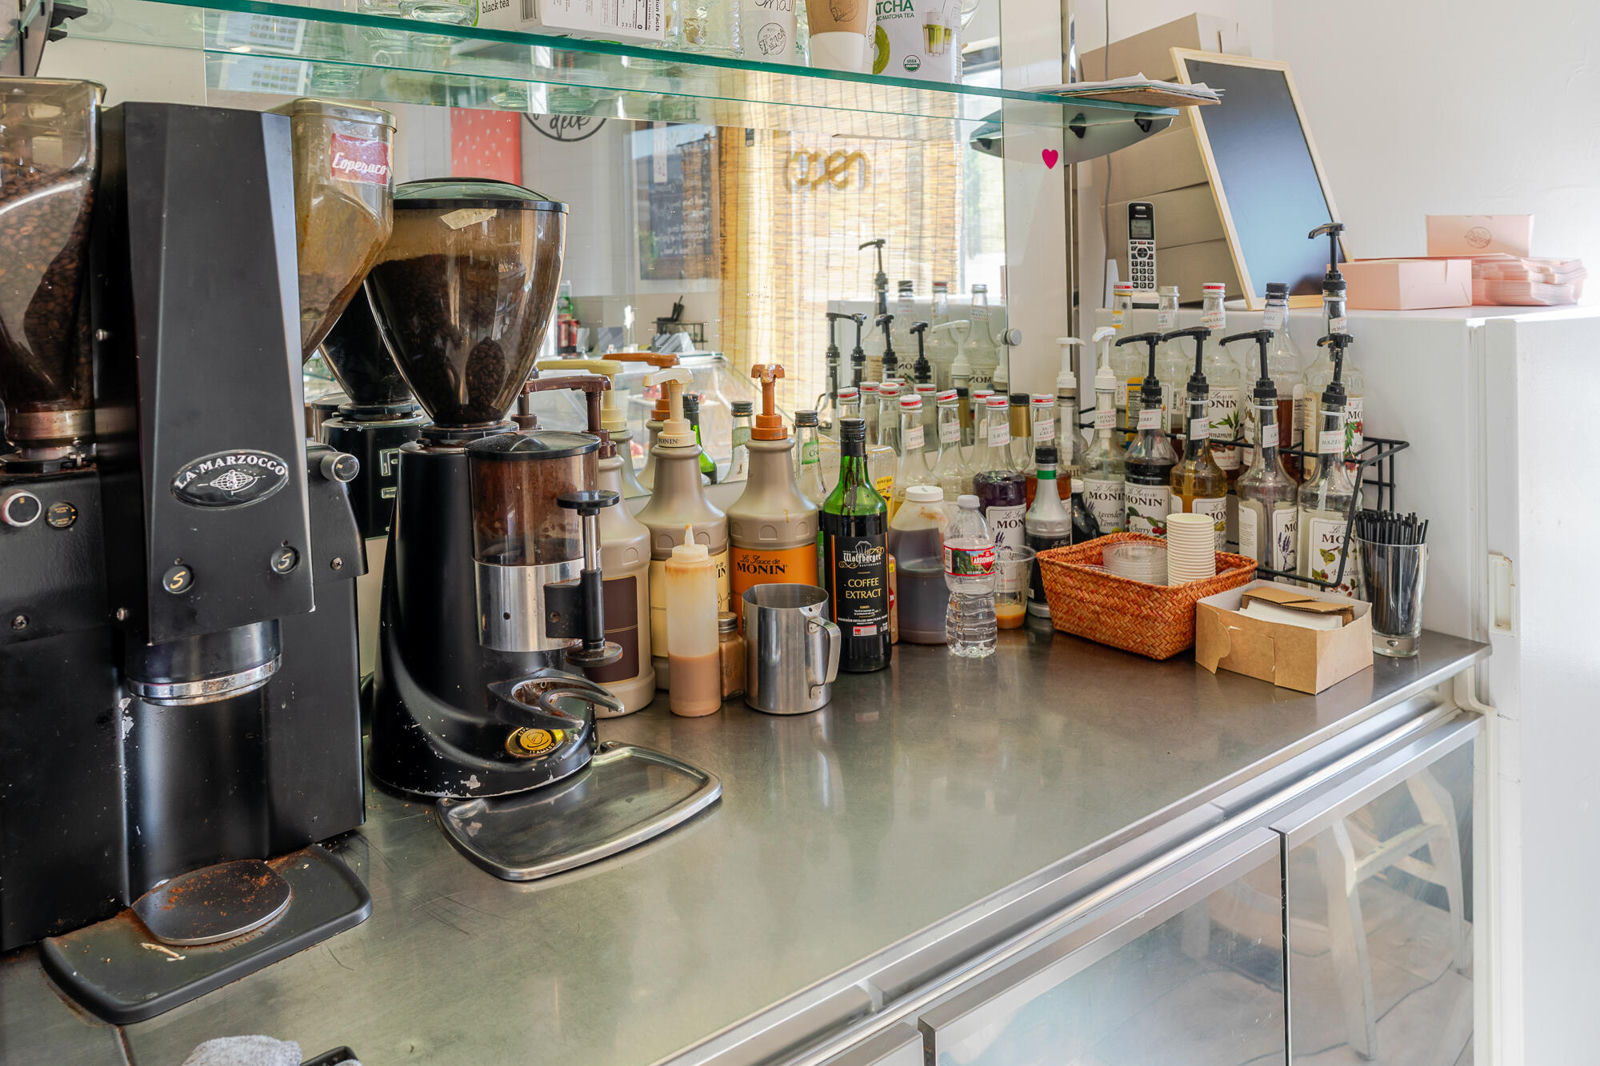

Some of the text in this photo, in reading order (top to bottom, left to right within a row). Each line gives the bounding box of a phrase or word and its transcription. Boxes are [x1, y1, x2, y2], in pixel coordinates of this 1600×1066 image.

[1208, 399, 1237, 408] ONIN
[174, 455, 286, 489] LA MARZOCCO
[996, 519, 1025, 529] MON
[736, 562, 786, 575] MONIN
[848, 577, 880, 588] COFFEE
[845, 588, 882, 600] EXTRACT
